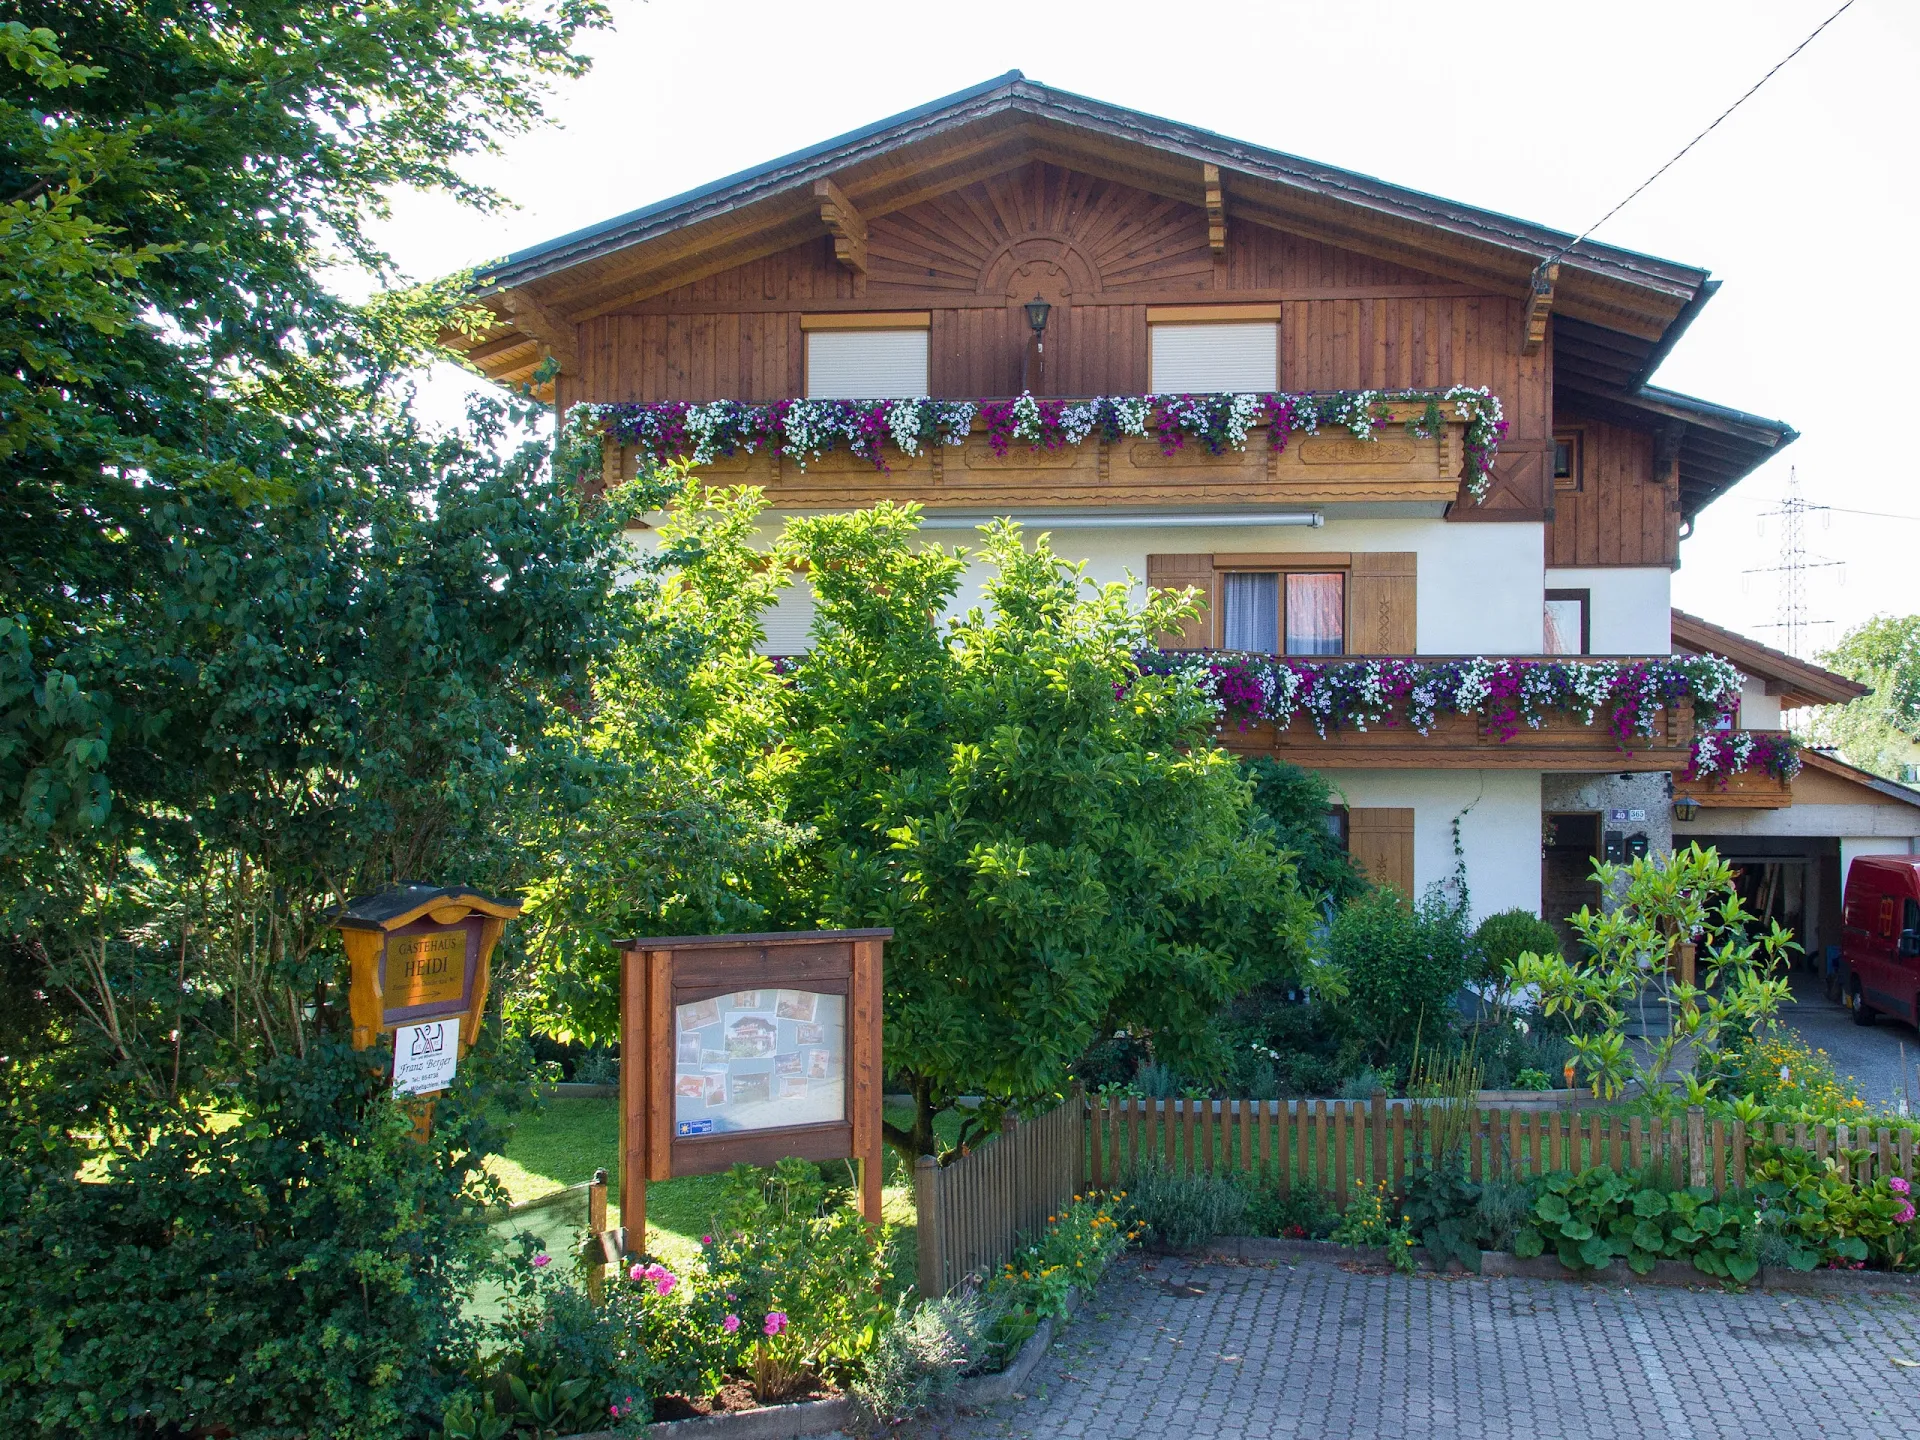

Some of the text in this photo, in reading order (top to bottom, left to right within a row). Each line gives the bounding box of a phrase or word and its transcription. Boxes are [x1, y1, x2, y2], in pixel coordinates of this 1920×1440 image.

[399, 938, 457, 956] GÄSTEHAUS
[404, 956, 448, 978] HEIDI
[397, 1057, 452, 1078] Franz Berger
